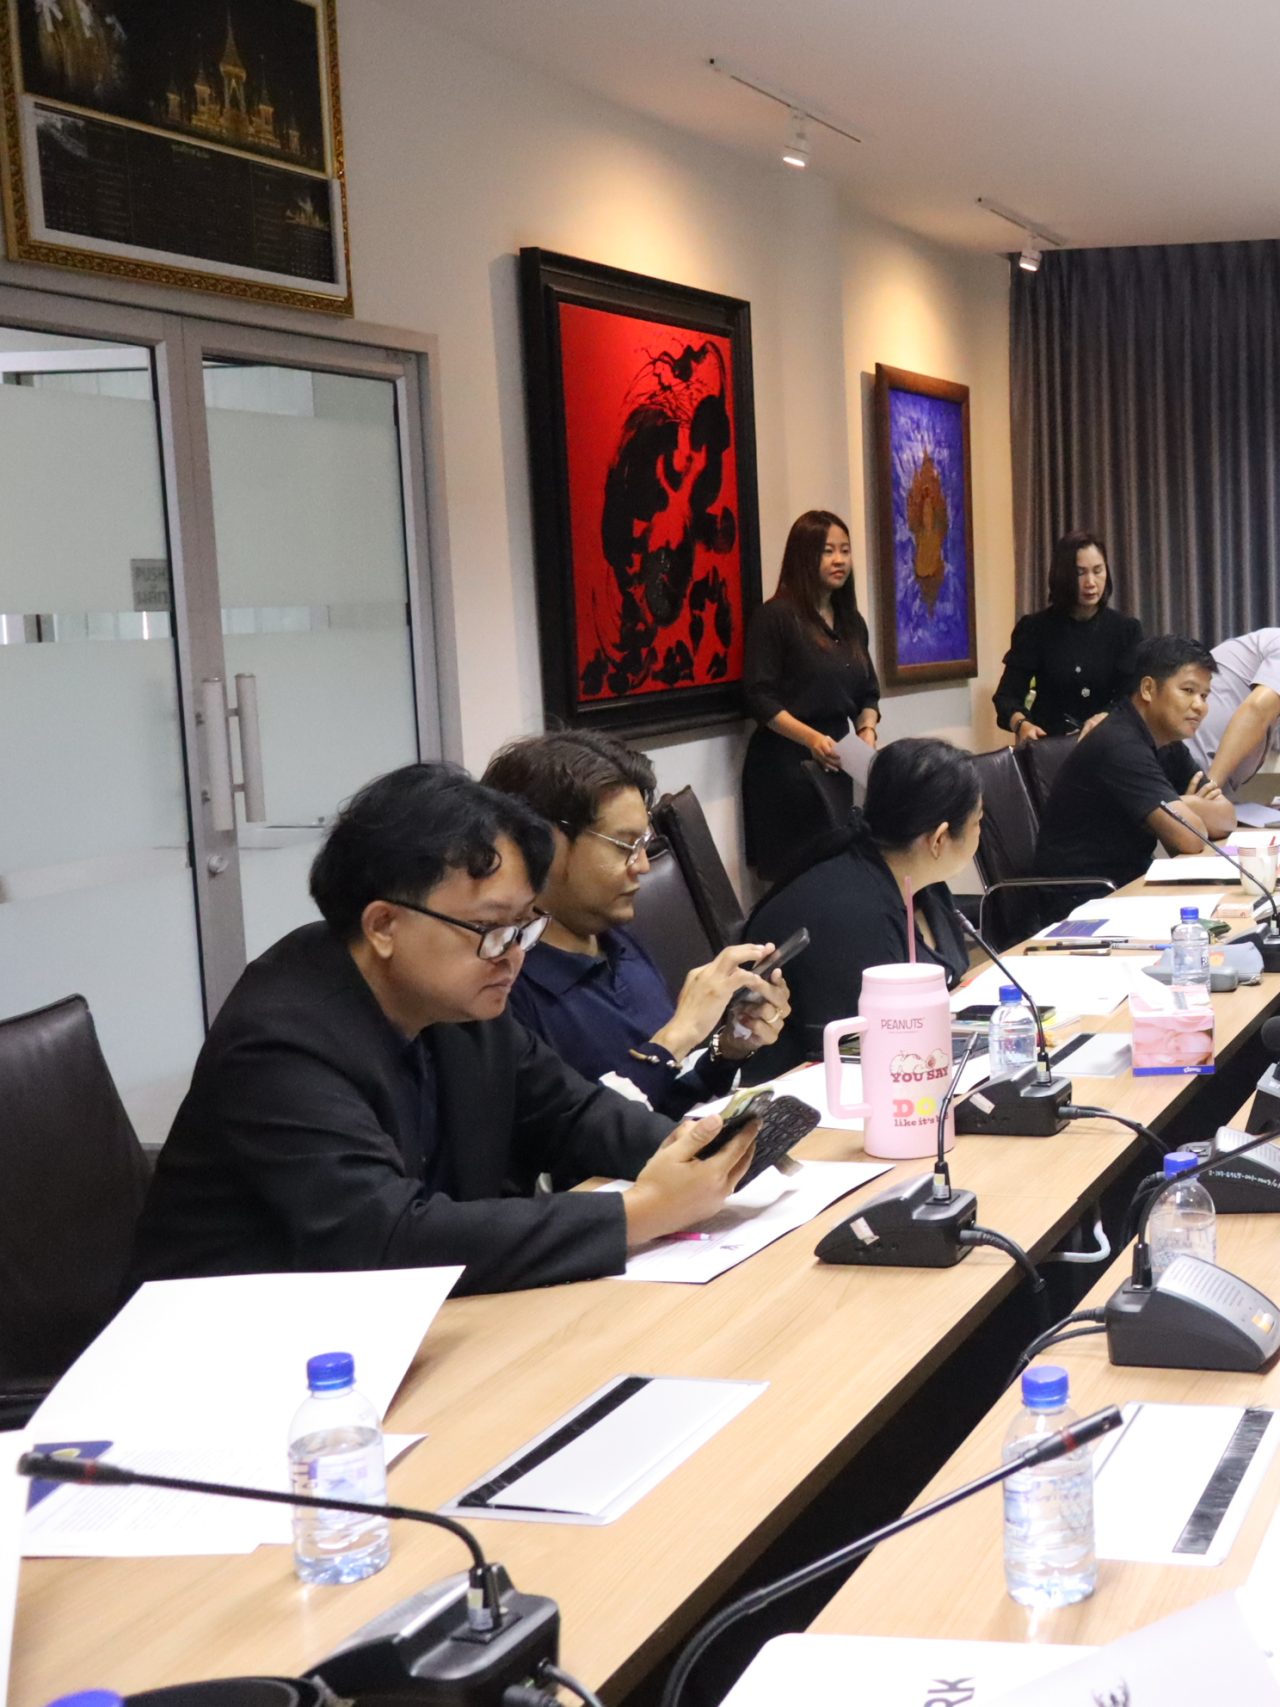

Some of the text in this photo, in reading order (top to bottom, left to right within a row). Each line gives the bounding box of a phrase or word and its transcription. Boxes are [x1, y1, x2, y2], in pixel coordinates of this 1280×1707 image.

[881, 1018, 924, 1030] PEANUTS
[890, 1066, 949, 1083] YOU SAY
[893, 1096, 943, 1118] DO
[894, 1118, 917, 1127] like
[918, 1116, 935, 1126] it's
